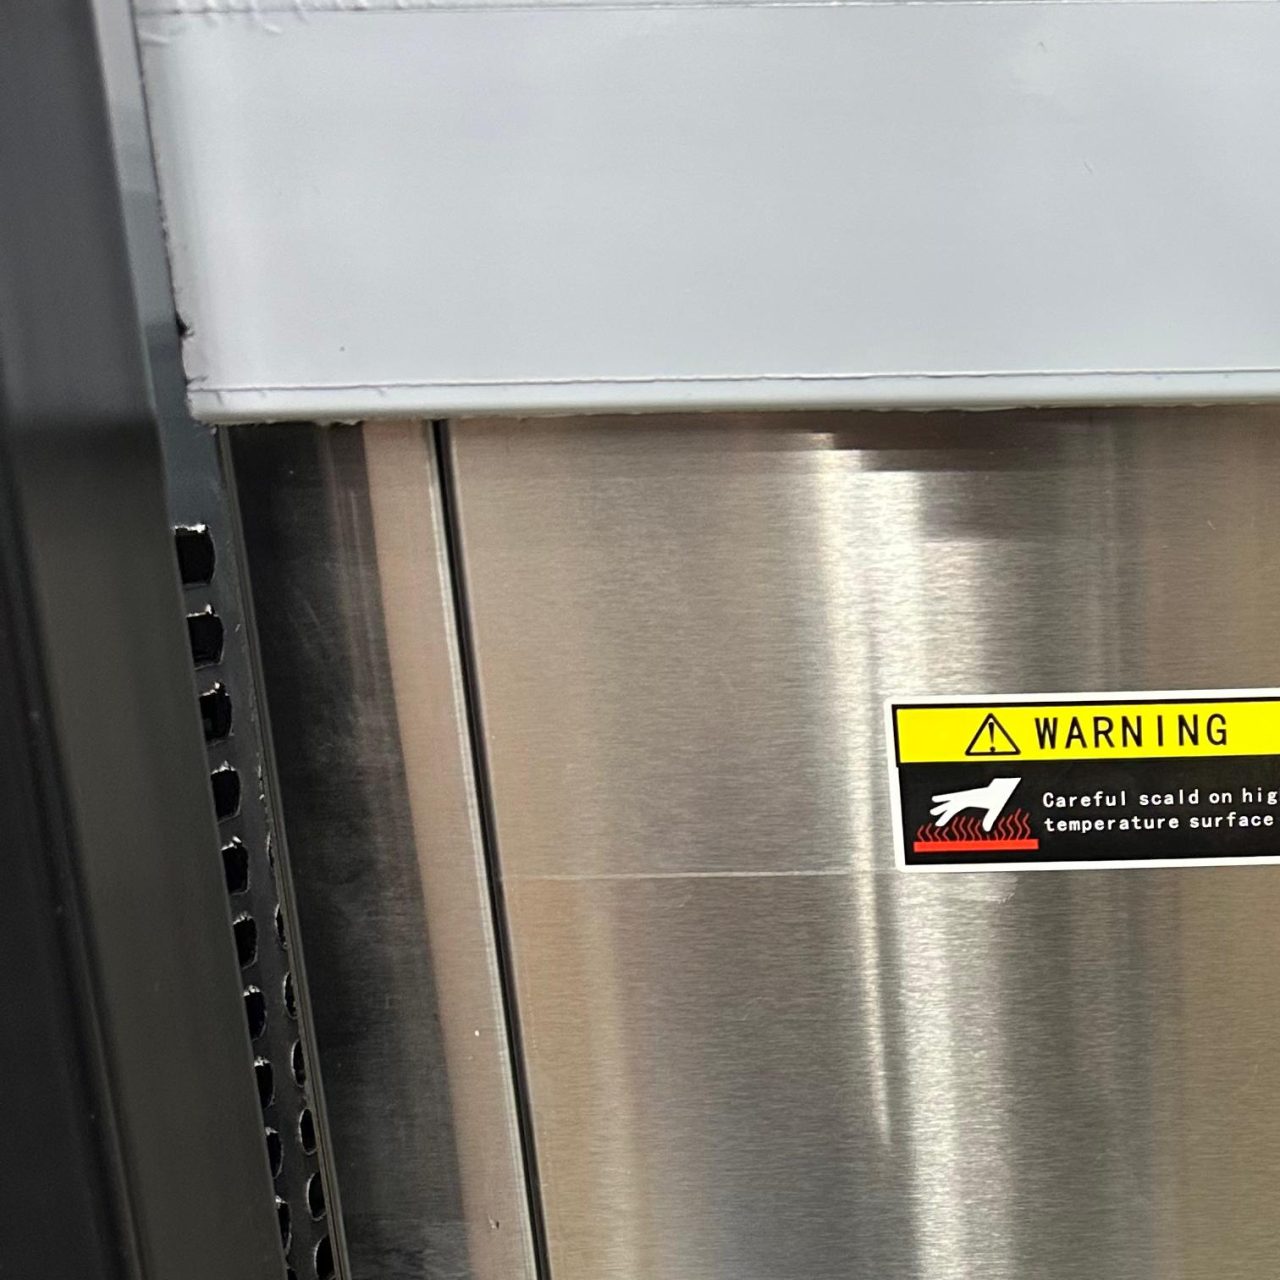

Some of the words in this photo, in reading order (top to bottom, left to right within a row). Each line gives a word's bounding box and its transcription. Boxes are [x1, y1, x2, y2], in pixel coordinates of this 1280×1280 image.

[1034, 713, 1229, 750] WARNING
[1042, 791, 1127, 808] Careful
[1139, 788, 1200, 806] scald
[1208, 791, 1233, 804] on
[1043, 815, 1180, 834] temperature
[1189, 811, 1275, 828] surface
